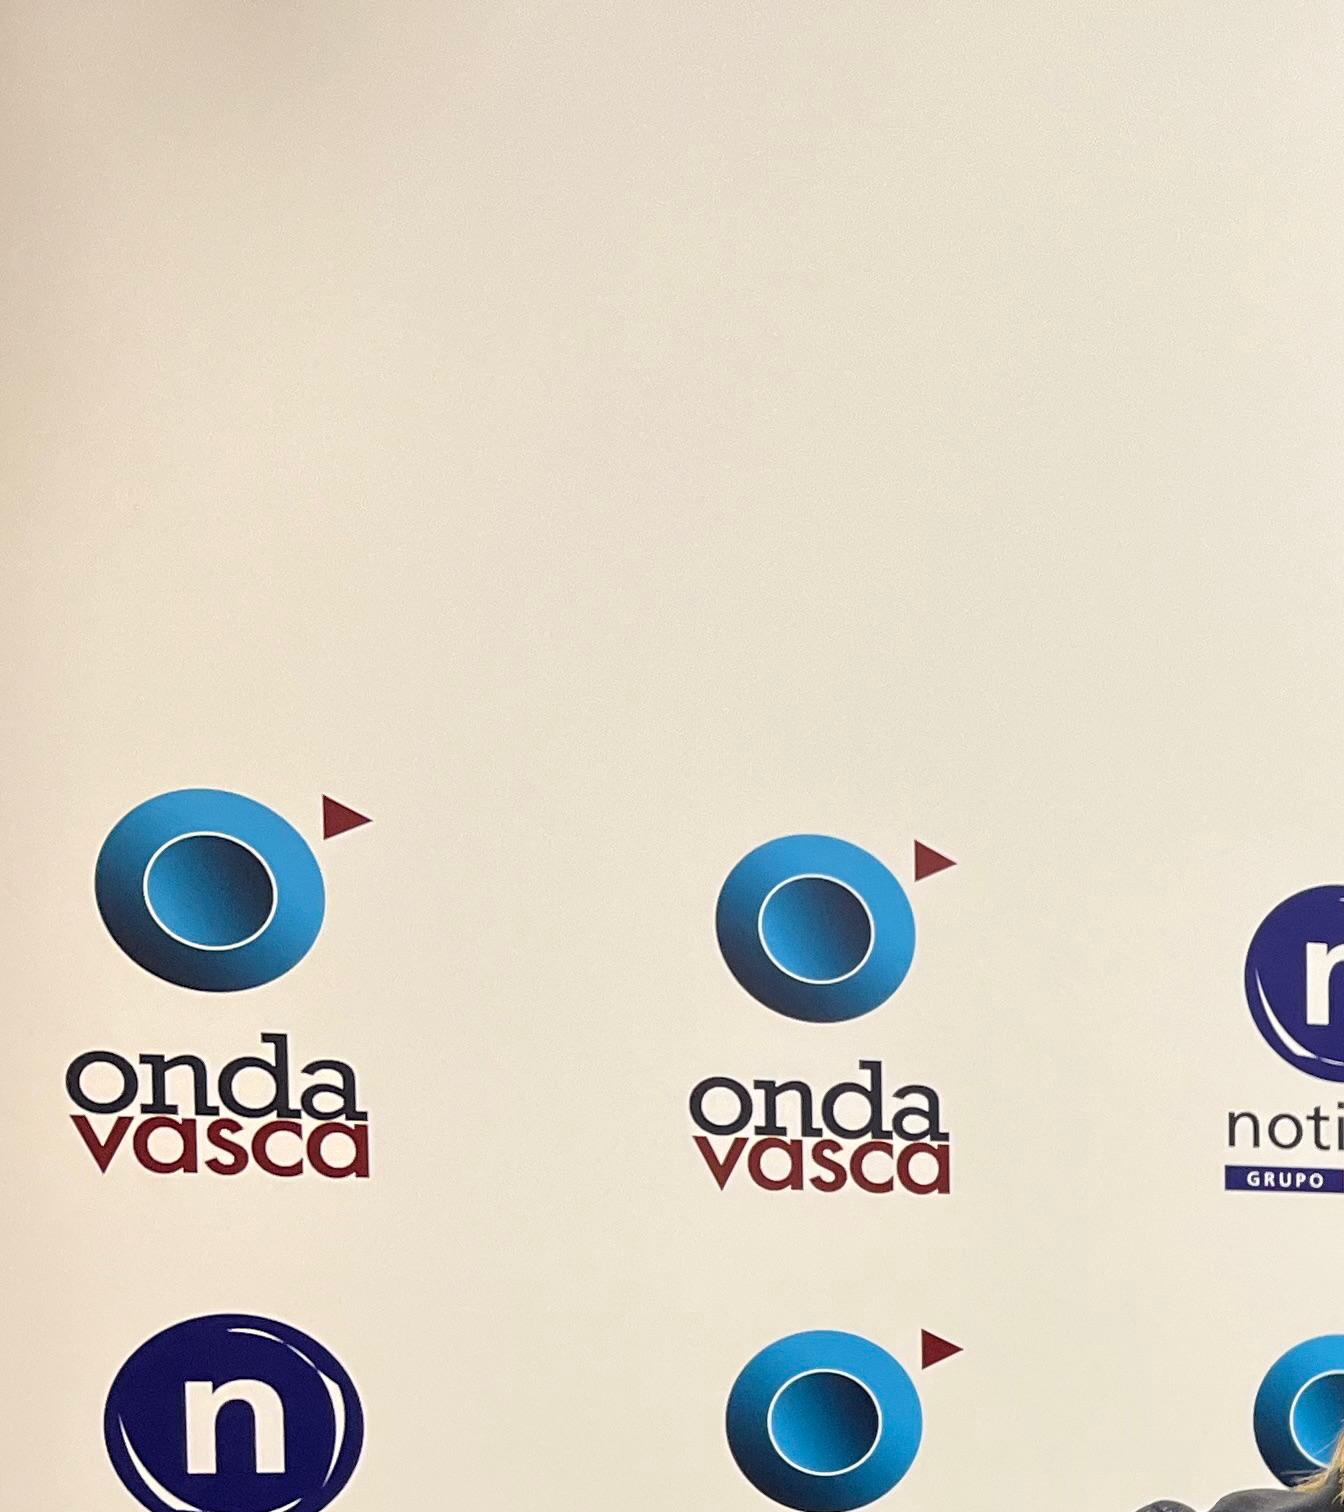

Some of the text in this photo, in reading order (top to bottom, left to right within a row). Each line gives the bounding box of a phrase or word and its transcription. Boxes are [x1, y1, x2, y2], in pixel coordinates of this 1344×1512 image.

[66, 1032, 368, 1121] onda
[690, 1060, 949, 1141] onda
[70, 1115, 370, 1178] vasca
[692, 1136, 950, 1194] vasca
[1246, 1171, 1324, 1188] GRUPO
[185, 1378, 285, 1474] n
